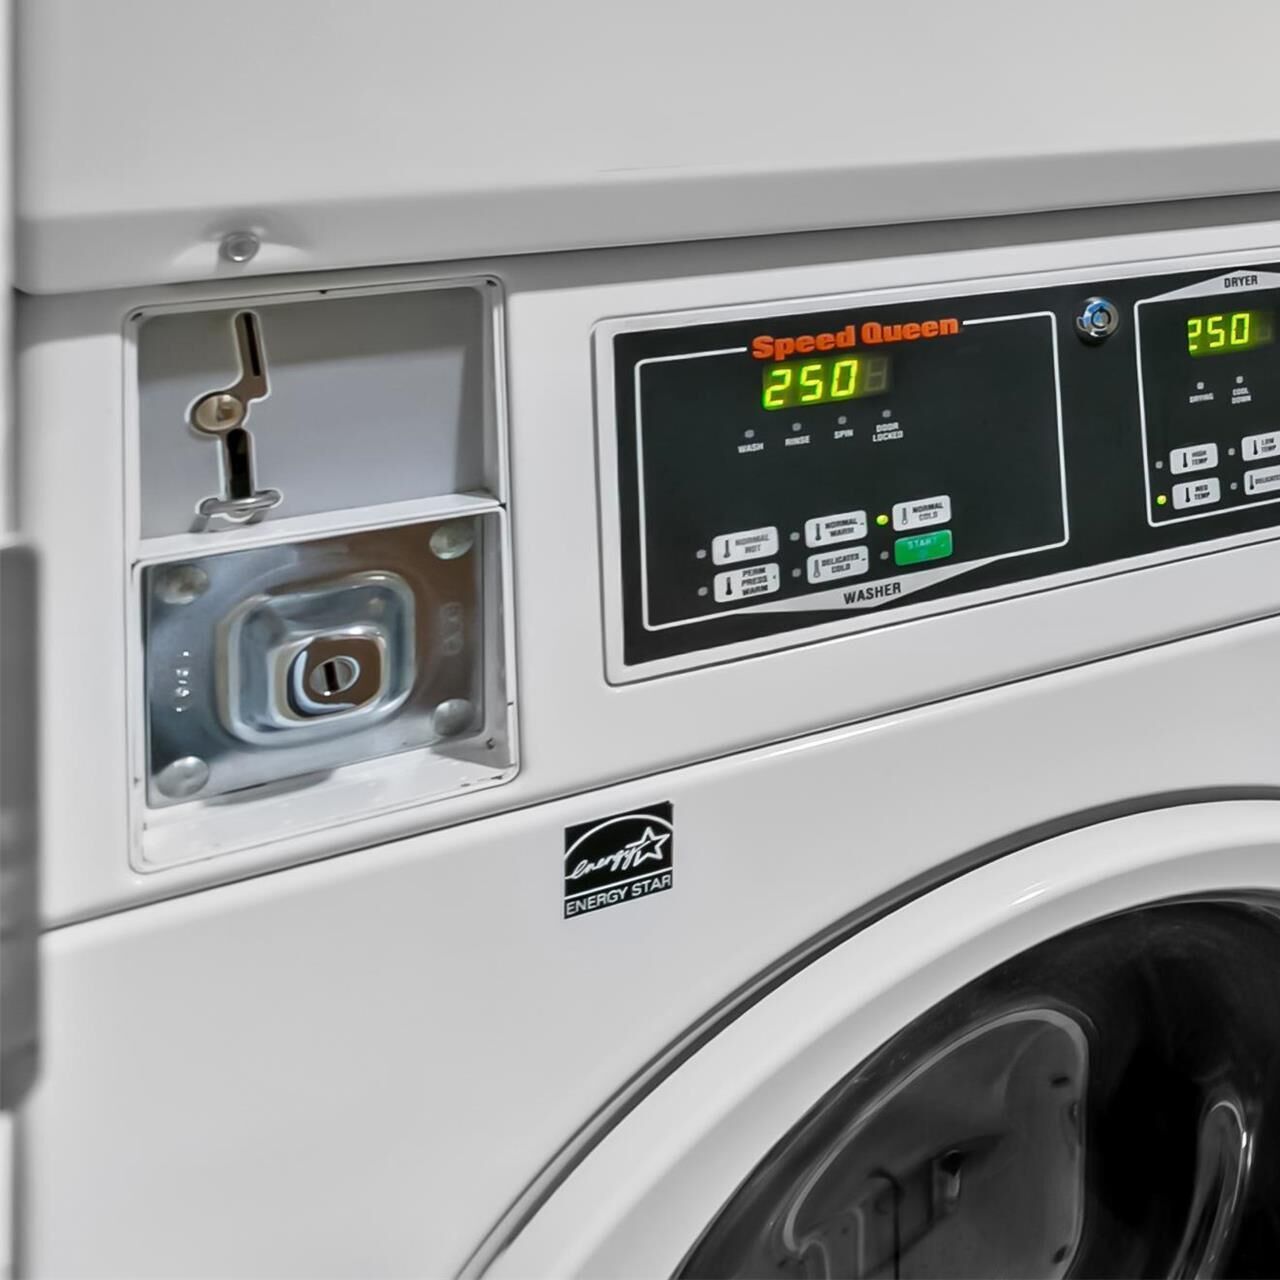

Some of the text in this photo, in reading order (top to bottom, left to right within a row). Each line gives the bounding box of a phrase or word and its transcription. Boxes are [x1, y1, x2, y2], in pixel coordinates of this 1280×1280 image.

[1224, 275, 1258, 288] DRYER
[1187, 313, 1250, 351] 250
[752, 318, 959, 360] Speed Queen
[765, 360, 858, 407] 250
[834, 428, 853, 439] SPIN
[876, 422, 899, 433] DOOR
[785, 435, 810, 446] RINSE
[872, 430, 903, 442] LOCKED
[738, 442, 764, 453] WASH
[912, 502, 944, 513] NORMAL
[919, 511, 938, 521] COLD
[825, 518, 858, 530] NORMAL
[742, 566, 766, 578] PERM
[741, 575, 768, 587] PRESS
[742, 584, 769, 596] WARM
[844, 582, 901, 605] WASHER
[566, 874, 671, 915] ENERGY STAR
